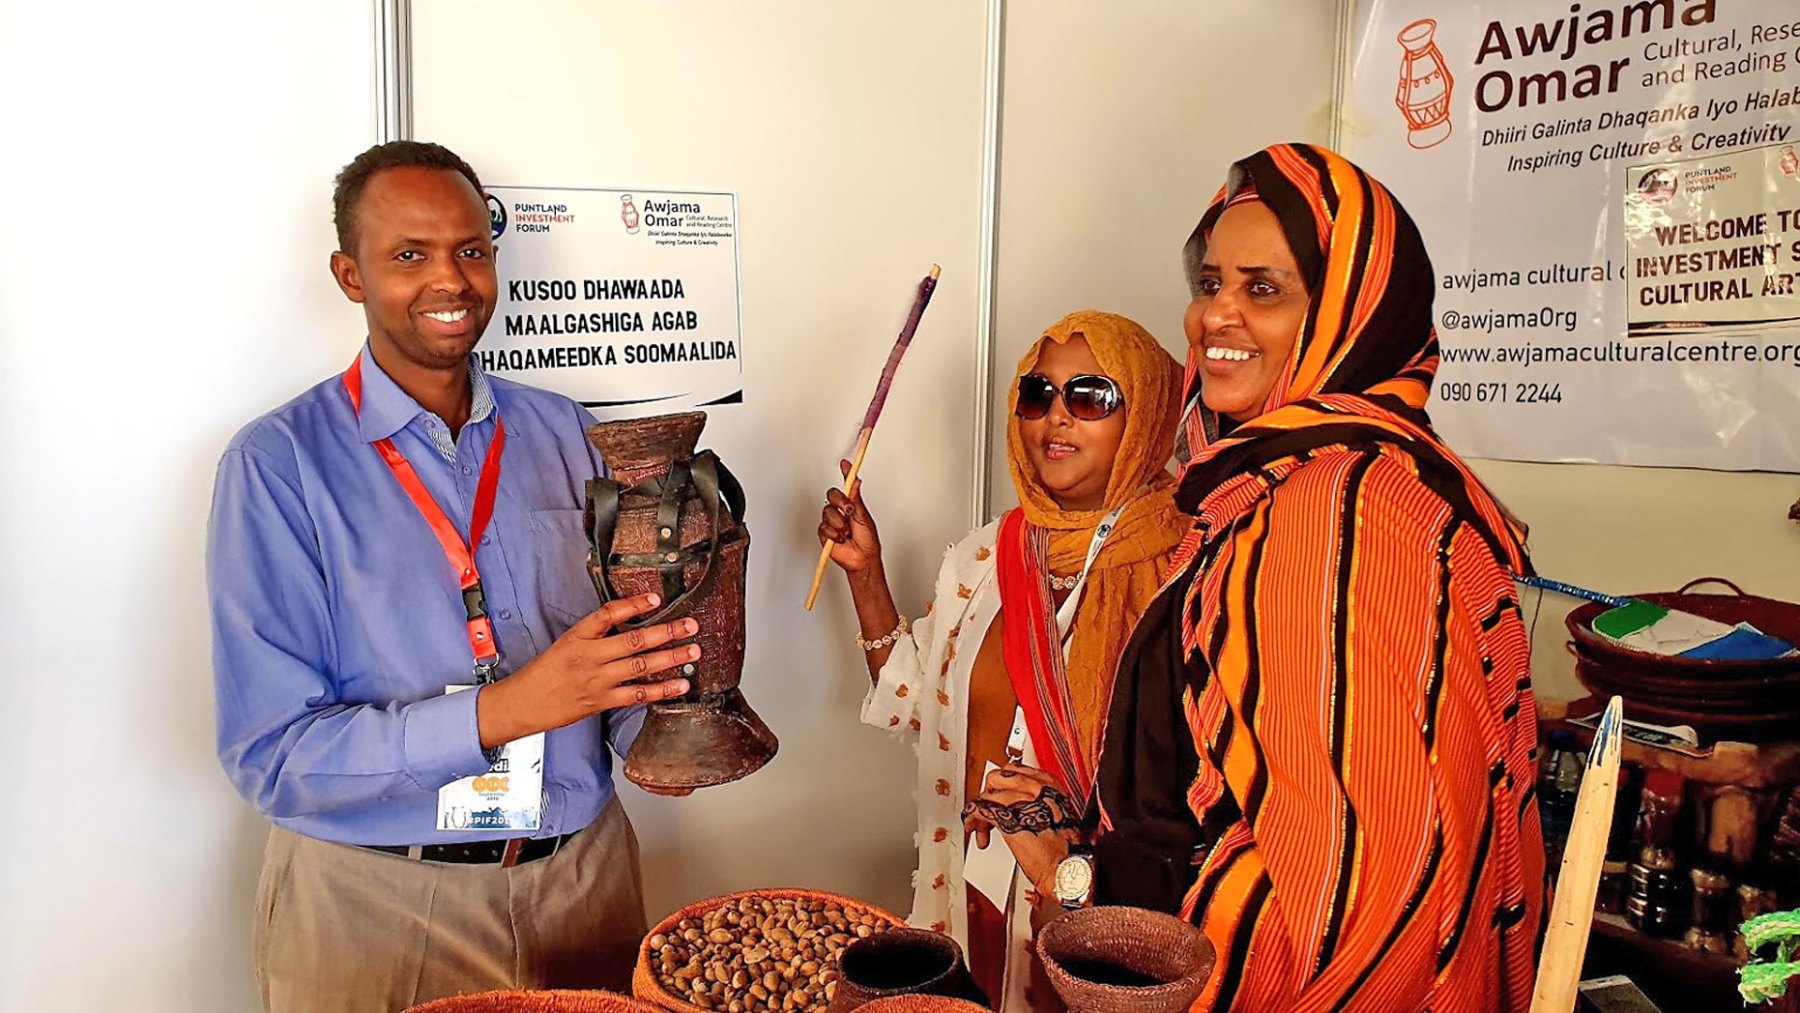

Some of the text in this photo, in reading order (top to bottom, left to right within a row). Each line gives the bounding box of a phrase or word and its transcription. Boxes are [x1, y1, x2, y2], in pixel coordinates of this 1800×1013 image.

[1474, 0, 1716, 65] Awjama
[1644, 28, 1742, 61] Cultural,
[1641, 63, 1685, 88] and
[1694, 52, 1787, 81] Reading
[1474, 57, 1630, 113] Omar
[1482, 124, 1527, 147] Dhiiri
[1532, 117, 1592, 140] Galinta
[1597, 103, 1700, 130] Dhaqanka
[1706, 99, 1738, 122] Iyo
[1507, 123, 1791, 173] Inspiring Culture & Creativity
[1685, 166, 1732, 178] PUNTLAND
[1685, 172, 1738, 186] INVESTMENT
[1685, 184, 1715, 194] FORUM
[515, 203, 567, 213] PUNTLAND
[515, 214, 575, 223] INVESTMENT
[644, 199, 701, 215] Awjama
[644, 214, 683, 227] Omar
[516, 224, 550, 233] FORUM
[1655, 212, 1767, 247] WELCOME
[1636, 243, 1781, 278] INVESTMENT
[1442, 269, 1521, 293] awjama
[1527, 260, 1612, 285] cultural
[509, 279, 685, 302] KUSOO DHAWAADA
[1640, 278, 1753, 306] CULTURAL
[505, 310, 698, 336] MAALGASHIGA AGAB
[473, 340, 737, 371] HAQAMEEDKA SOOMAALIDA
[1440, 382, 1562, 403] 090 671 2244
